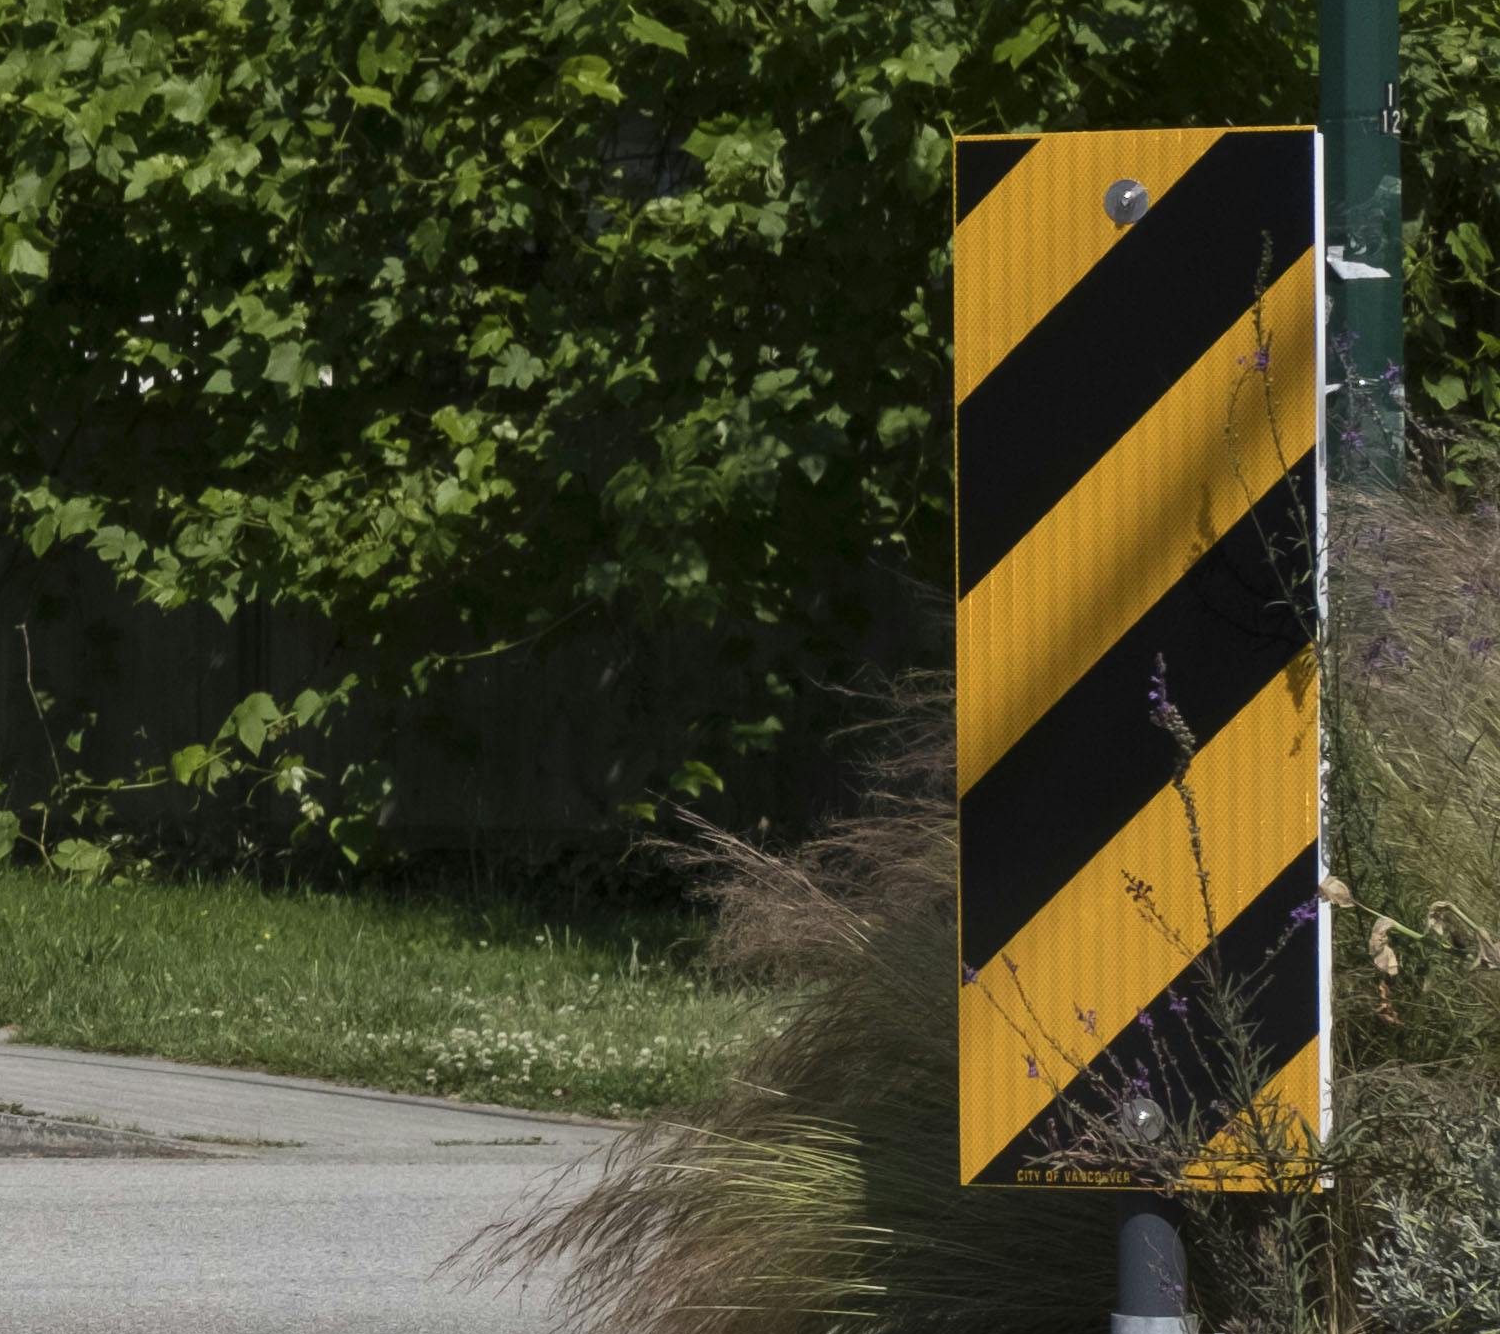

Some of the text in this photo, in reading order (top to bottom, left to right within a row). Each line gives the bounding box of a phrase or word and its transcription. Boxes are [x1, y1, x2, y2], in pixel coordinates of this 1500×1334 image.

[1382, 110, 1401, 134] 12
[1016, 1169, 1040, 1182] CITY
[1045, 1170, 1060, 1182] OF
